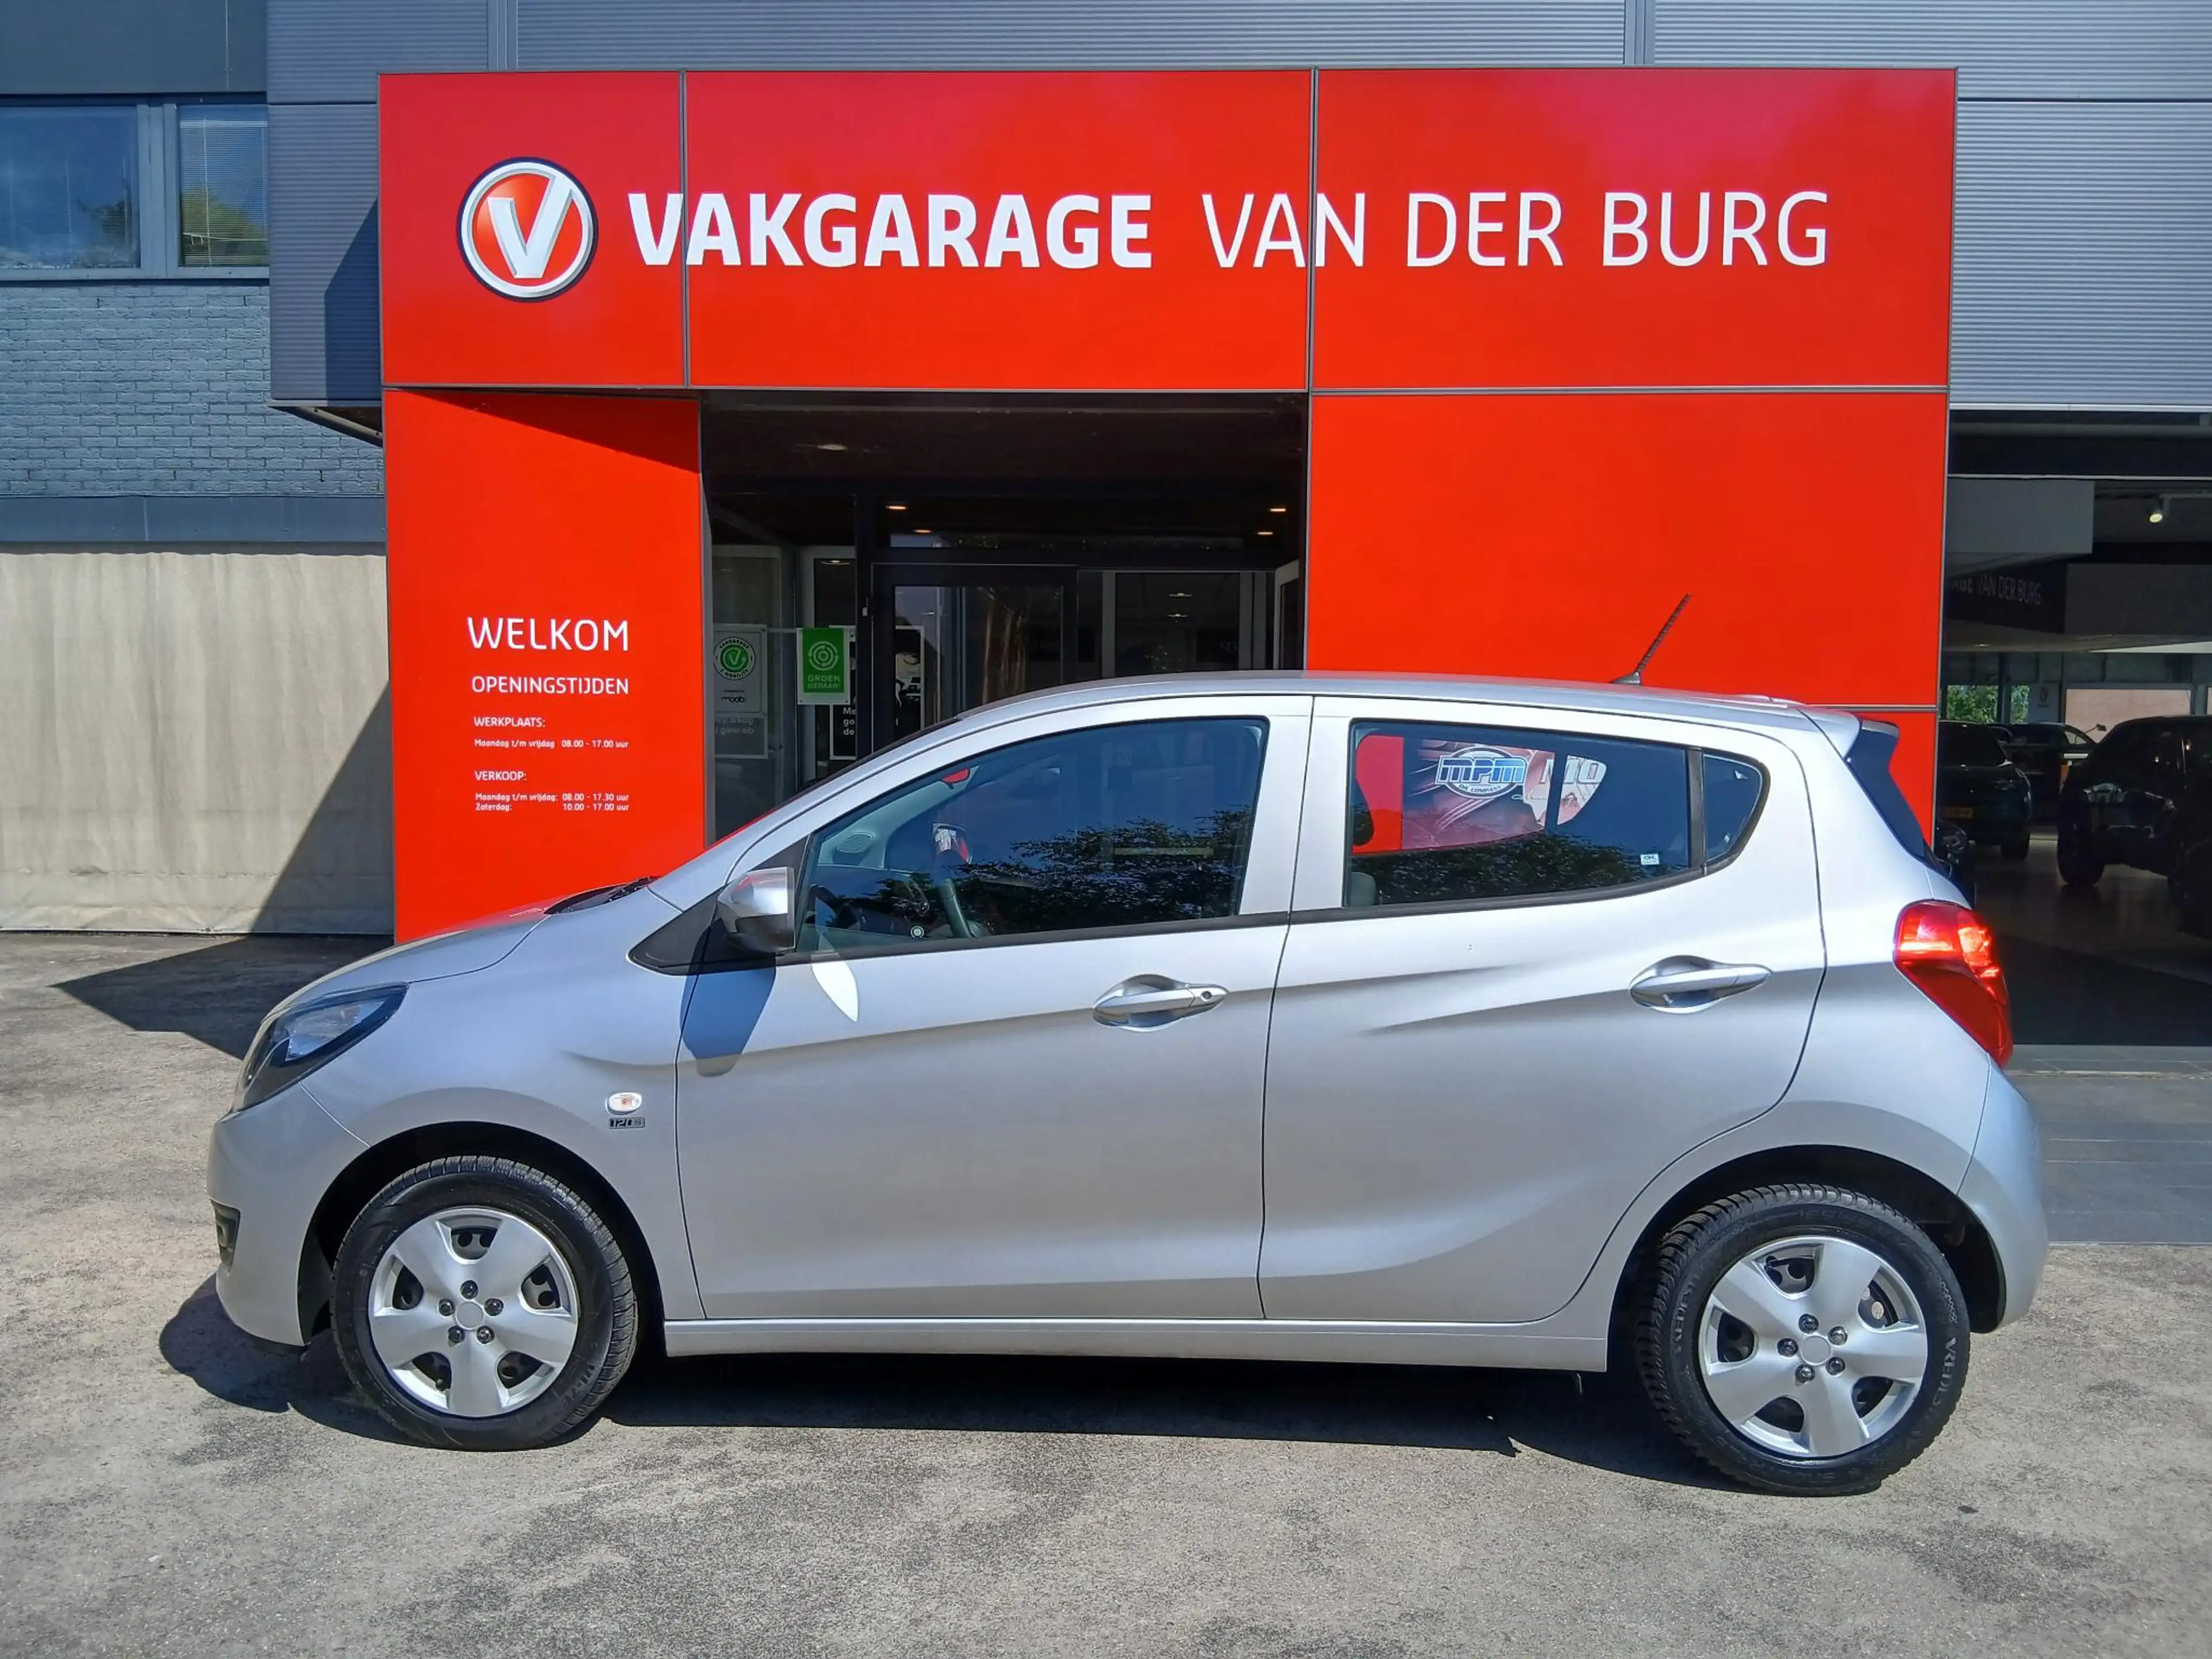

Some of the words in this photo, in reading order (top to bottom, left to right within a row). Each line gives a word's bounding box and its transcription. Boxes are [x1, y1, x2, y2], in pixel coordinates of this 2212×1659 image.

[628, 193, 1152, 268] VAKGARAGE
[1202, 193, 1365, 268] VAN
[1407, 192, 1563, 267] DER
[1603, 191, 1827, 267] BURG
[467, 616, 628, 652] WELKOM
[472, 676, 628, 695] OPENINGSTIJDEN
[474, 716, 546, 728] WERKPLAATS:
[474, 739, 509, 748] Maandag
[511, 739, 527, 748] t/m
[529, 740, 555, 749] vrijdag
[474, 770, 527, 781] VERKOOP:
[475, 793, 510, 803] Maandag
[512, 793, 527, 801] t/m
[475, 802, 512, 813] Zaterdag:
